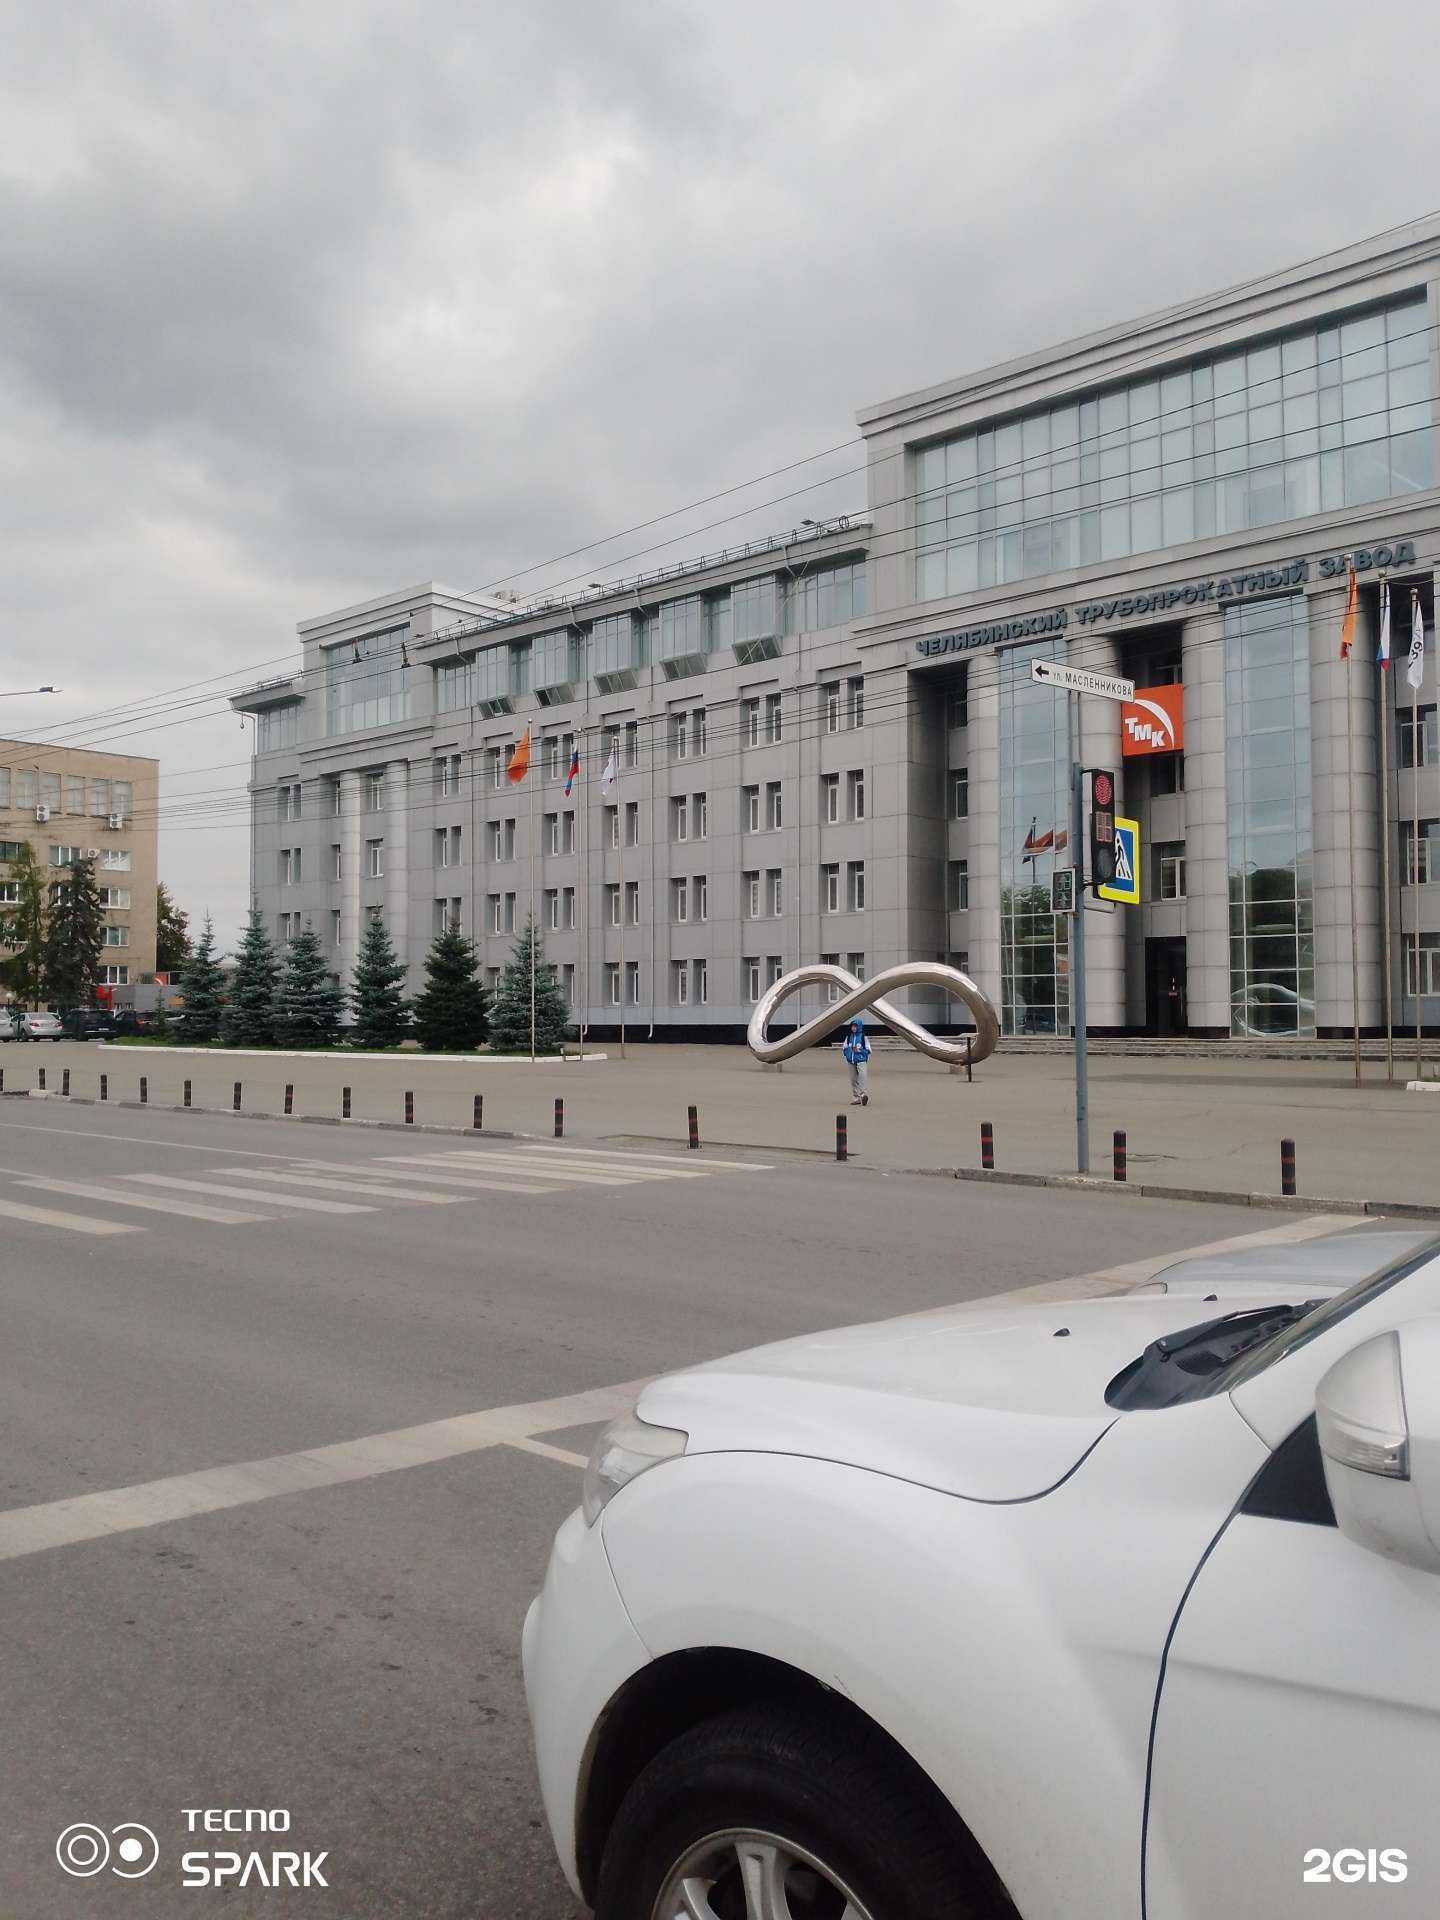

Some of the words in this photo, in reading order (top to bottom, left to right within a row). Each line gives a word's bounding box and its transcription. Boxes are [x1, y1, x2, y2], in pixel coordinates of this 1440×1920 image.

[916, 608, 1068, 656] ЧЕЛЯБИНСКИЙ
[1075, 558, 1309, 625] ТРУБОПРОКАТНЫЙ
[1052, 673, 1063, 682] ул.
[1065, 672, 1132, 696] МАСЛЕННИКОВА
[1125, 717, 1166, 748] ТМК
